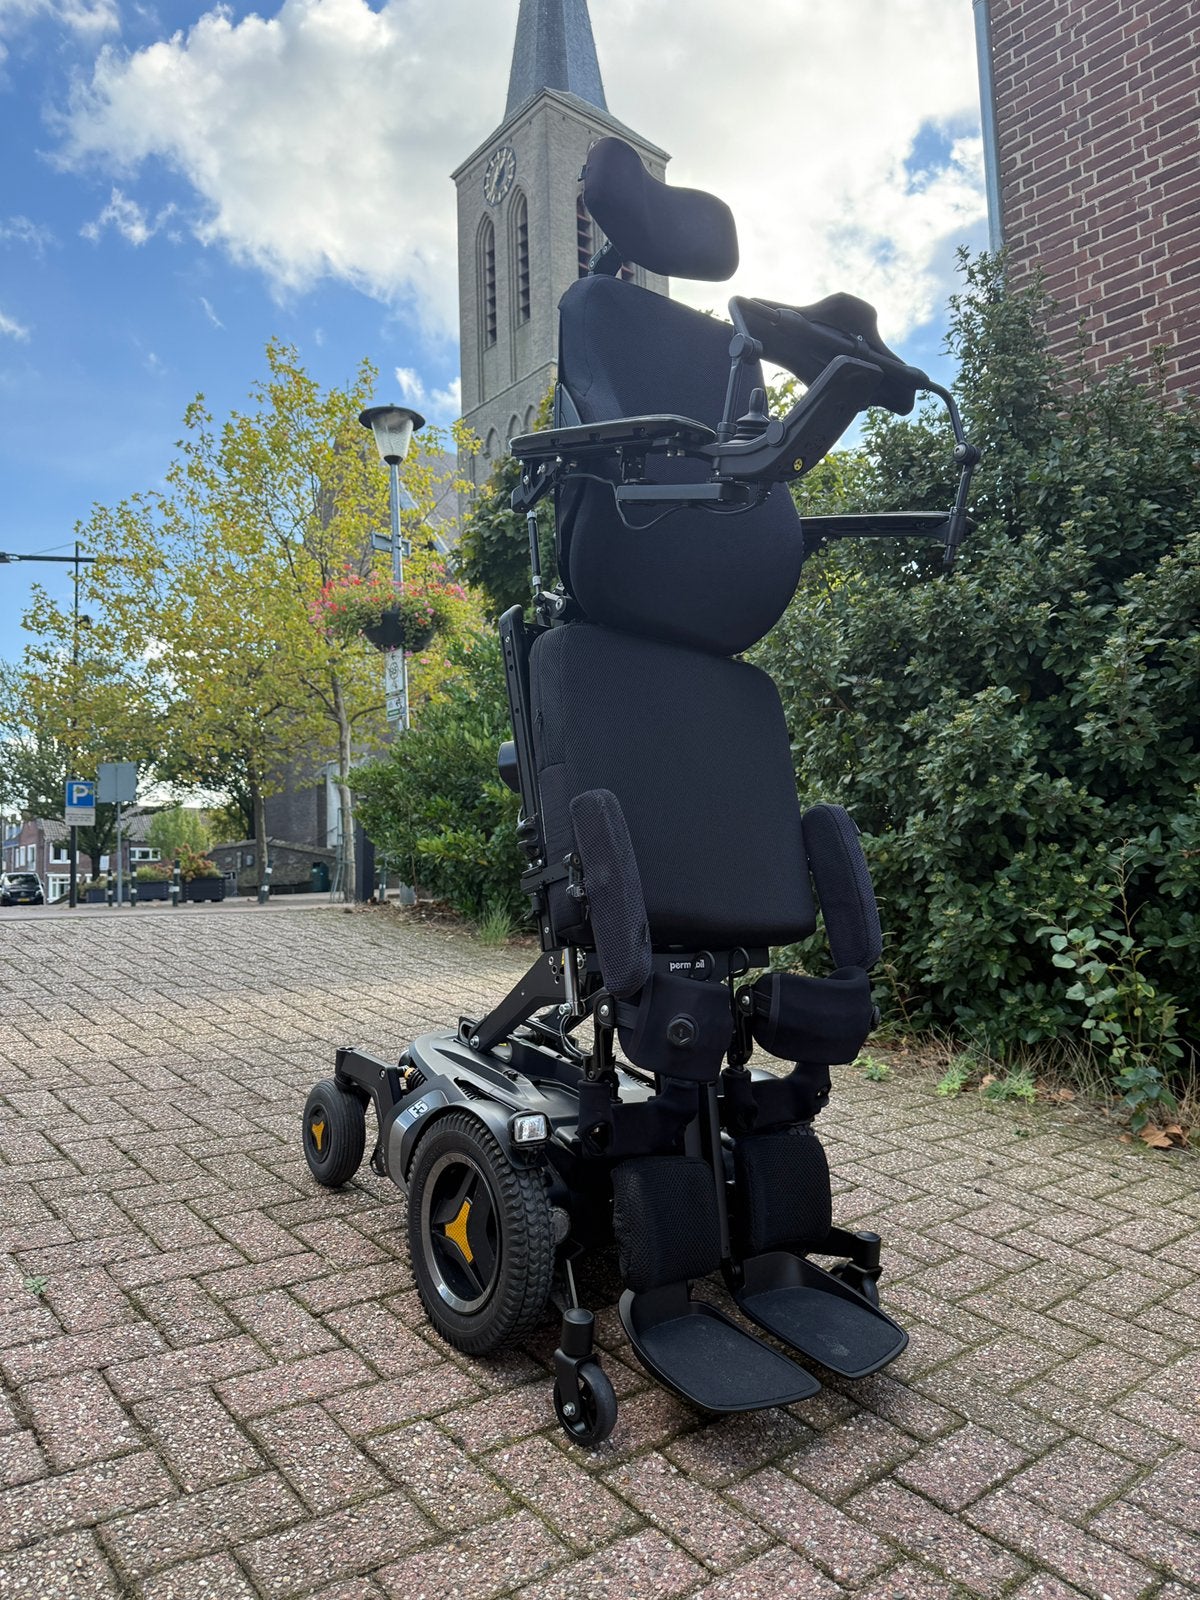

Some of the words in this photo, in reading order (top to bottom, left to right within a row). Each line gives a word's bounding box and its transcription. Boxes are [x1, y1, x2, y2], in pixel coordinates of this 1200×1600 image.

[72, 784, 89, 805] P
[669, 959, 705, 972] permbil
[407, 1100, 428, 1118] F5
